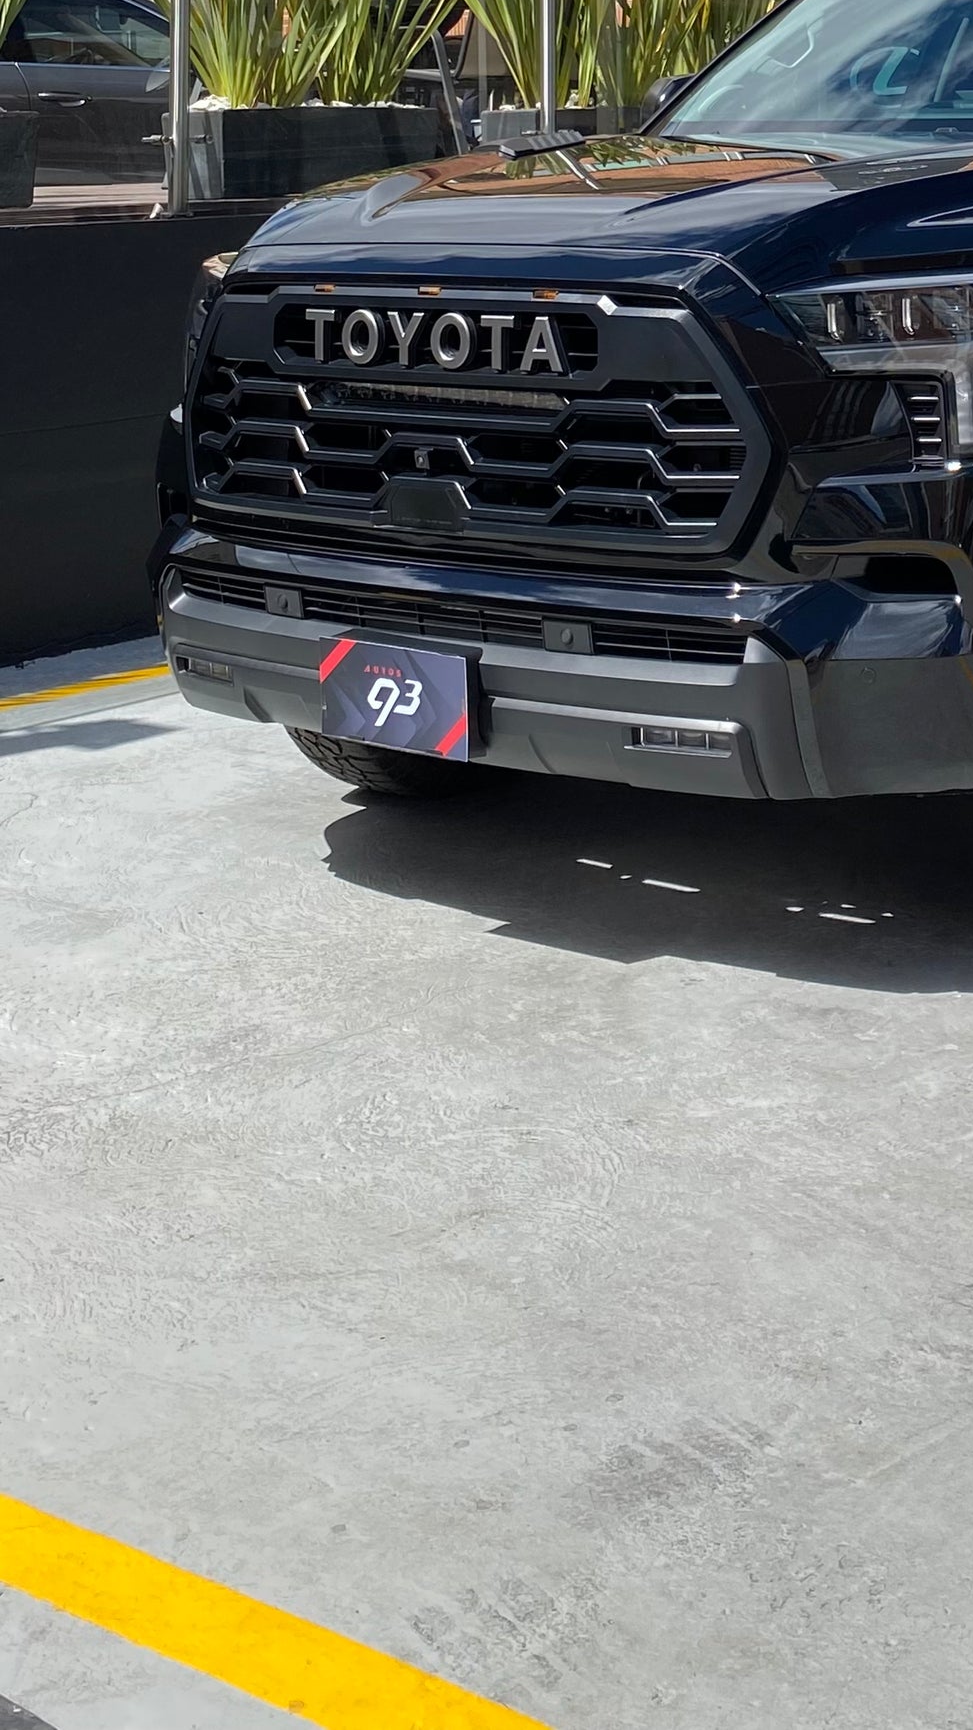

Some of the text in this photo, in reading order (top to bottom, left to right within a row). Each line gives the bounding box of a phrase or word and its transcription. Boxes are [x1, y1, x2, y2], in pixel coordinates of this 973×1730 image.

[305, 308, 566, 373] TOYOTA
[364, 664, 403, 678] AUTOS
[367, 677, 423, 727] 93
